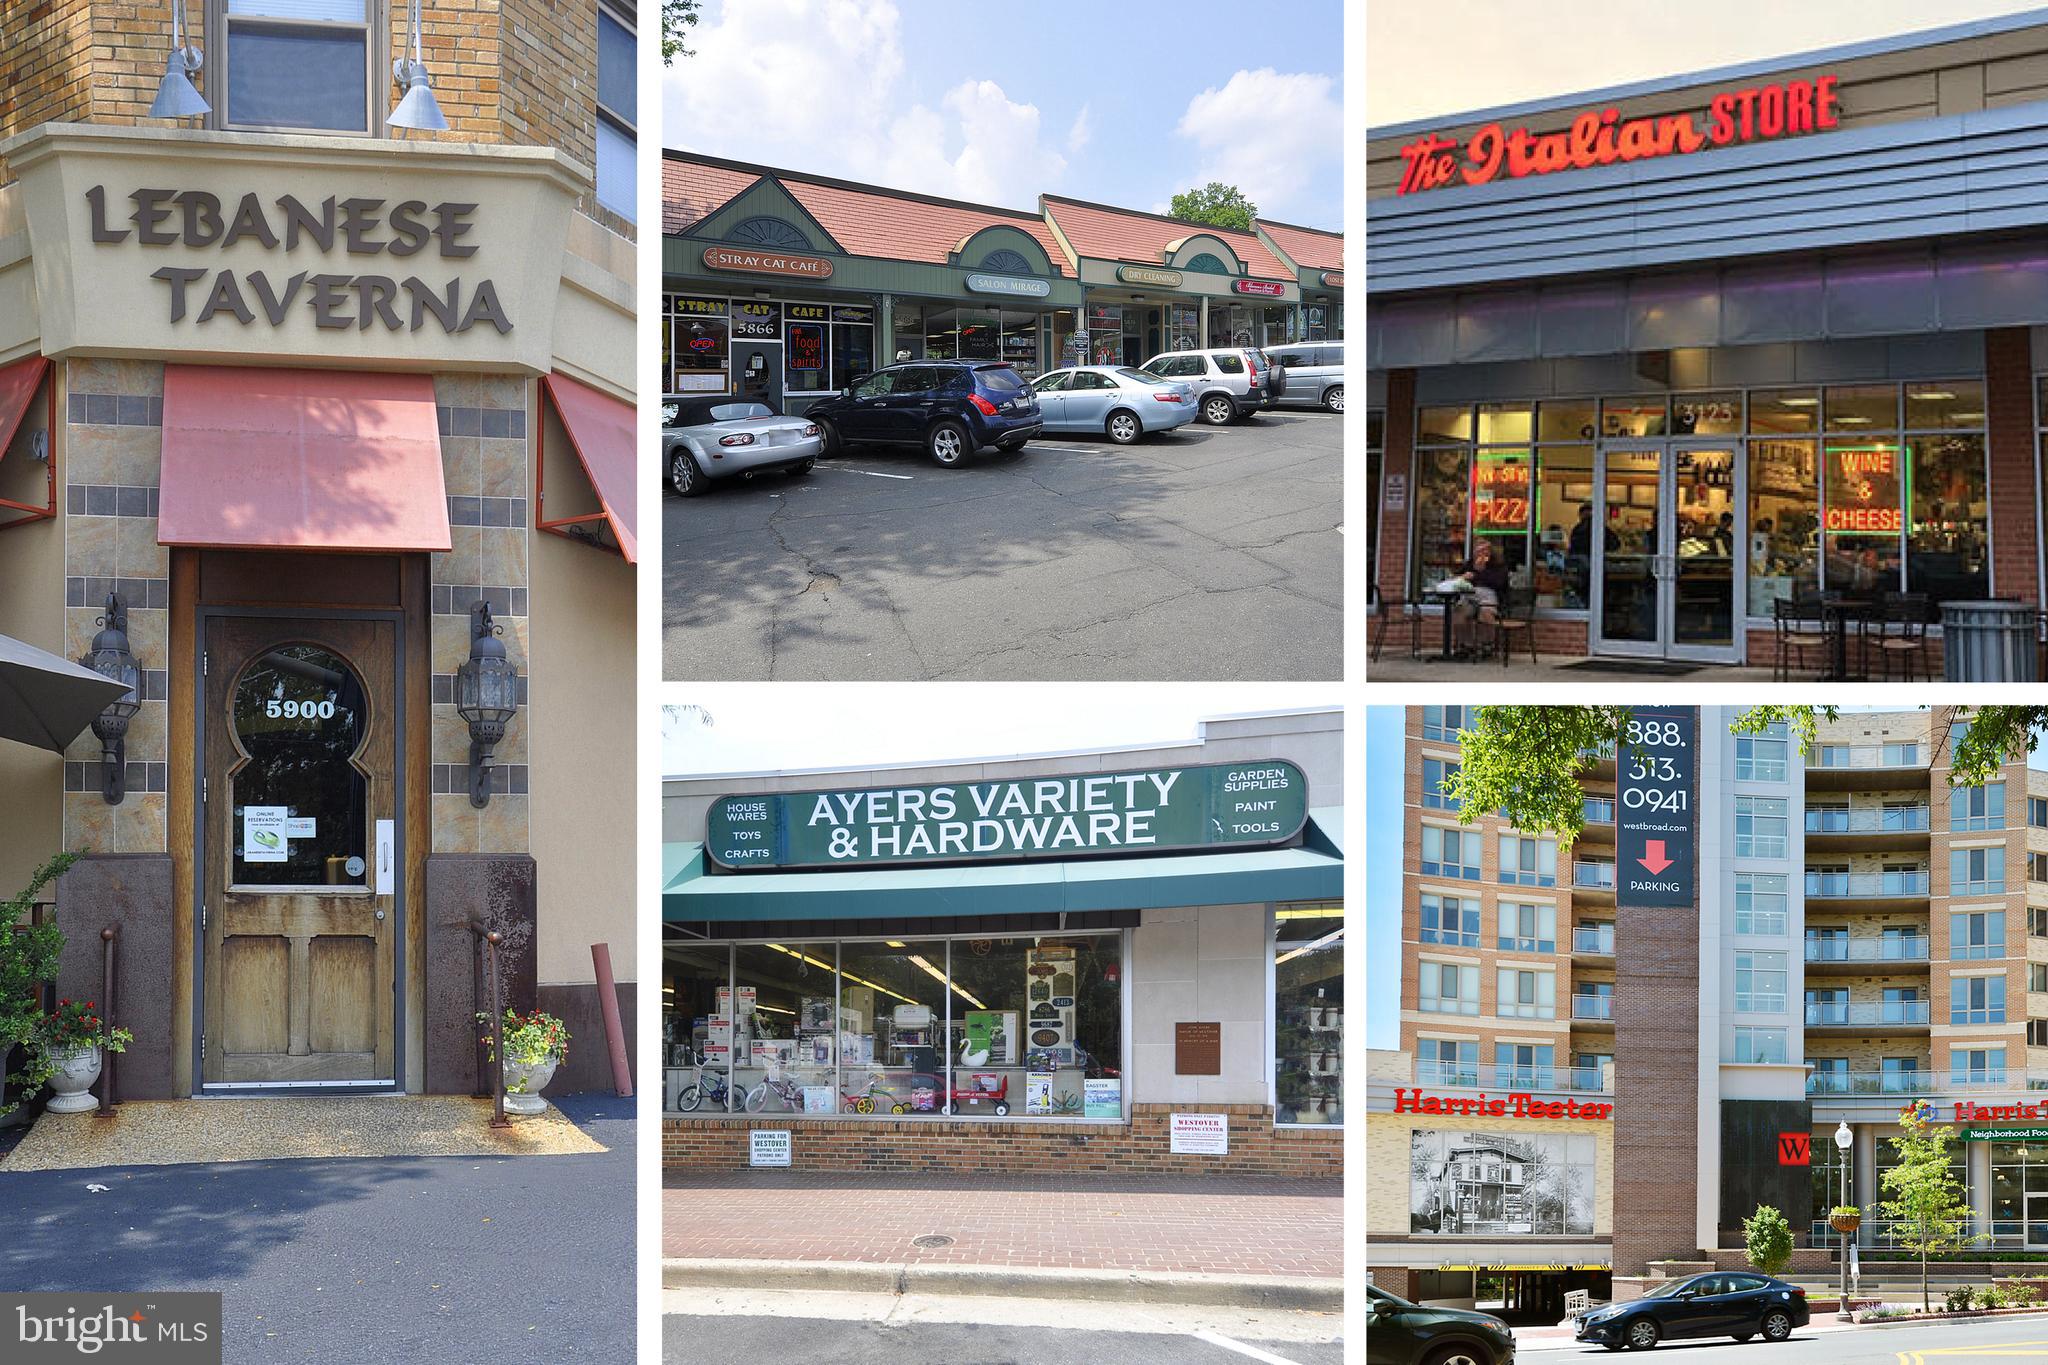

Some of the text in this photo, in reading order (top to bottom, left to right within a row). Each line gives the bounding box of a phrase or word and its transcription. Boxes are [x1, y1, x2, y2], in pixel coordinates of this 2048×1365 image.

[1395, 75, 1839, 197] The Italian STORE
[85, 184, 480, 258] LEBANESE
[719, 253, 818, 272] STRAY CAT CAFÉ
[978, 279, 1042, 292] SALON MIRAGE
[1129, 270, 1176, 283] DRY CLEANING
[150, 266, 514, 335] TAVERNA
[677, 300, 727, 313] STRAY
[743, 304, 770, 315] CAT
[792, 306, 824, 318] CAFE
[737, 322, 774, 335] 5866
[689, 339, 715, 348] OPEN
[795, 335, 821, 349] food
[791, 357, 821, 370] spirits
[1683, 401, 1732, 424] 3125
[1840, 452, 1891, 473] WINE
[1858, 480, 1873, 499] &
[1828, 508, 1904, 530] CHEESE
[266, 700, 335, 719] 5900
[1626, 720, 1687, 748] 888.
[1228, 768, 1286, 782] GARDEN
[1628, 756, 1682, 782] 313.
[1224, 778, 1289, 792] SUPPLIES
[727, 803, 767, 813] HOUSE
[807, 771, 1182, 827] AYERS VARIETY
[1235, 800, 1277, 812] PAINT
[1622, 787, 1687, 814] 0941
[726, 811, 768, 822] WARES
[733, 831, 762, 841] TOYS
[828, 809, 1156, 859] & HARDWARE
[1232, 822, 1280, 834] TOOLS
[1623, 822, 1688, 832] westbroad.com
[725, 848, 770, 859] CRAFTS
[1630, 881, 1680, 892] PARKING
[1393, 1088, 1614, 1120] Harris Teeter
[1954, 1101, 2039, 1122] Harris
[1970, 1129, 2030, 1140] Neighborhood
[1779, 1137, 1808, 1161] W
